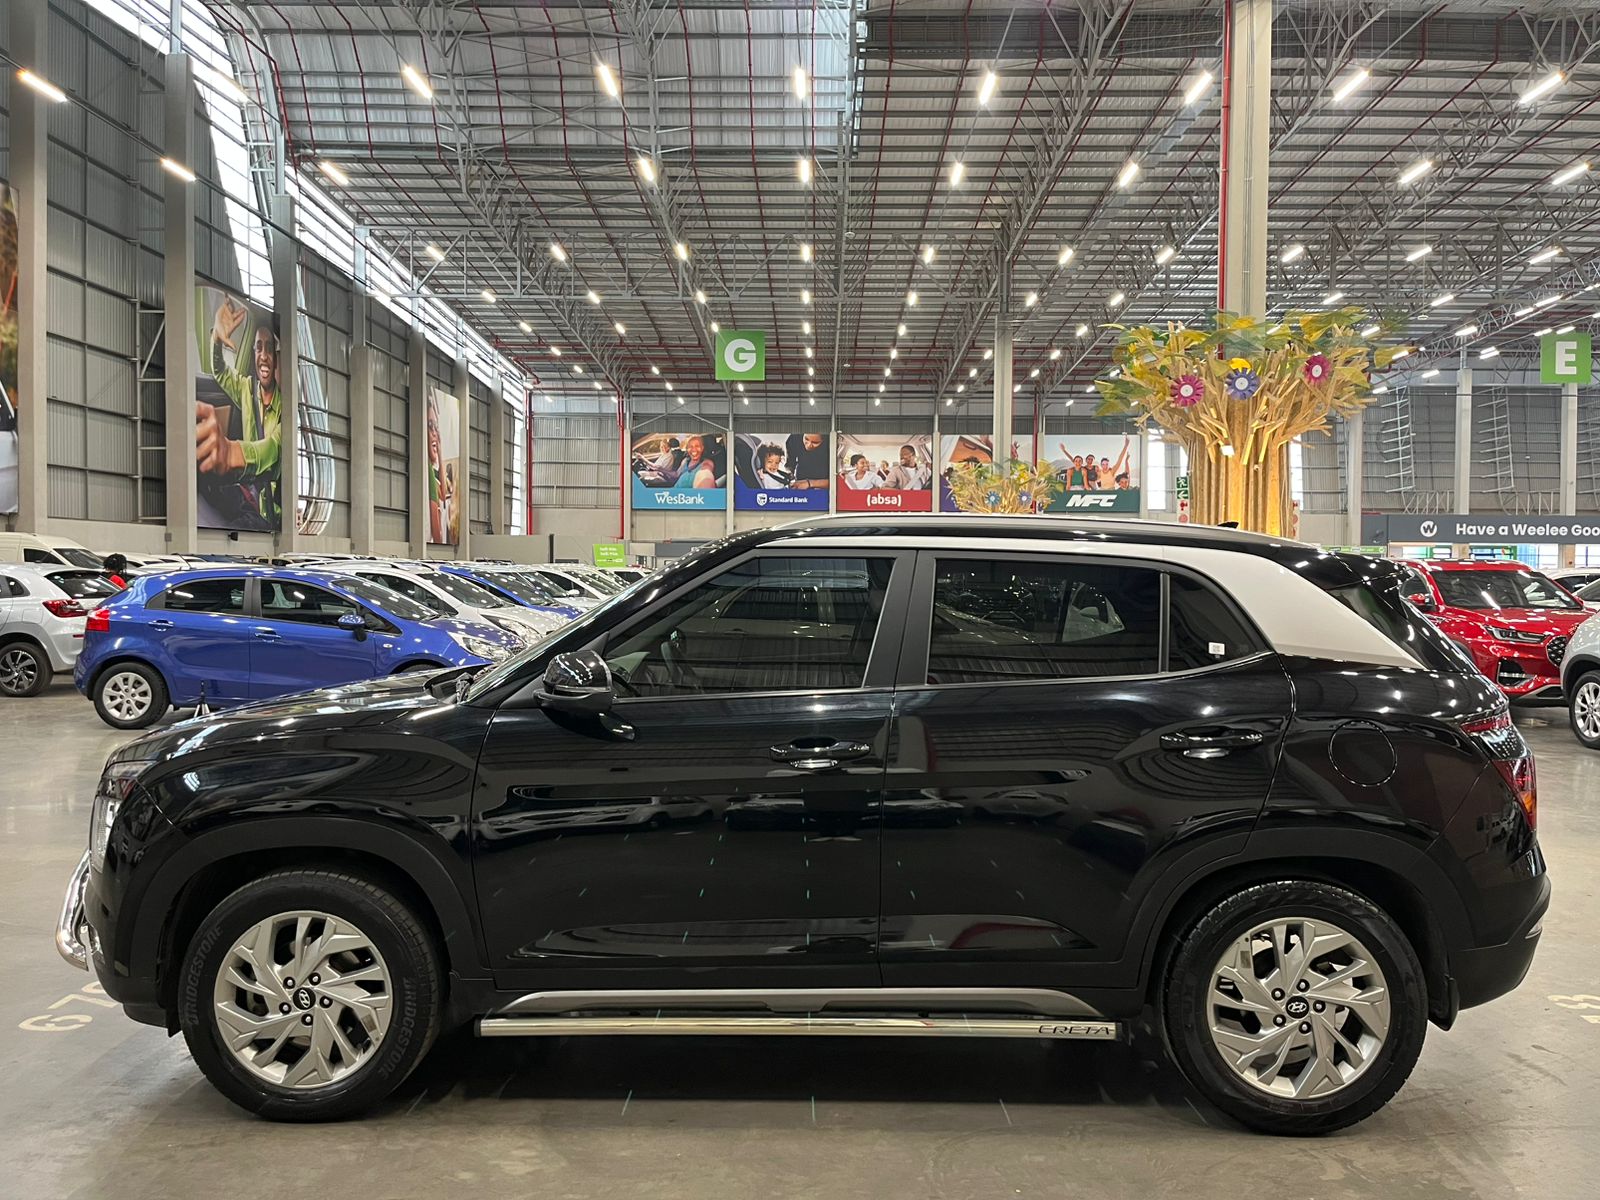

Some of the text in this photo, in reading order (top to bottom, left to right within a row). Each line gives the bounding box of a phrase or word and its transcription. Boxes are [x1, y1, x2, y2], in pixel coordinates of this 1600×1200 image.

[724, 338, 757, 373] G
[1555, 341, 1577, 375] E
[654, 491, 705, 505] WesBank
[1066, 494, 1117, 507] MFC
[1455, 523, 1496, 536] Have
[1498, 525, 1509, 536] a
[1512, 523, 1568, 536] Weelee
[1571, 524, 1600, 537] Goo
[1038, 1024, 1111, 1036] CRETA
